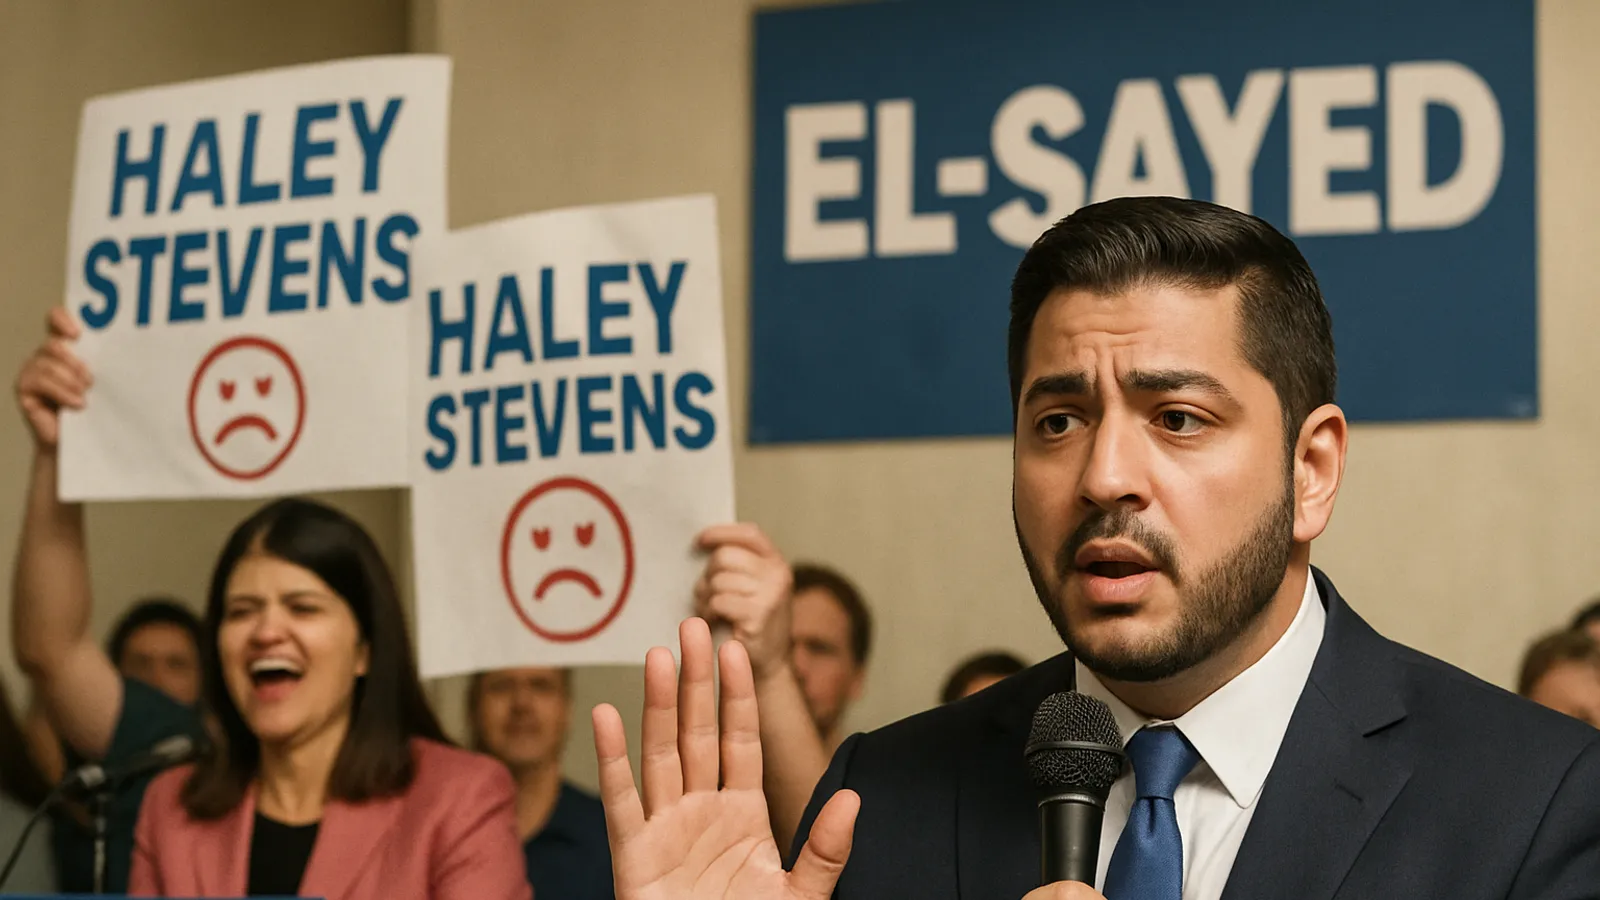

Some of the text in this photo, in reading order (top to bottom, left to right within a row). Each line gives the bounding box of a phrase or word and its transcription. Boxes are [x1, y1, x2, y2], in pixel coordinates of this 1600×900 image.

[109, 97, 405, 218] HALEY
[784, 60, 1504, 262] EL-SAYED
[79, 213, 420, 330] STEVENS
[428, 261, 688, 378] HALEY
[425, 371, 717, 471] STEVENS
